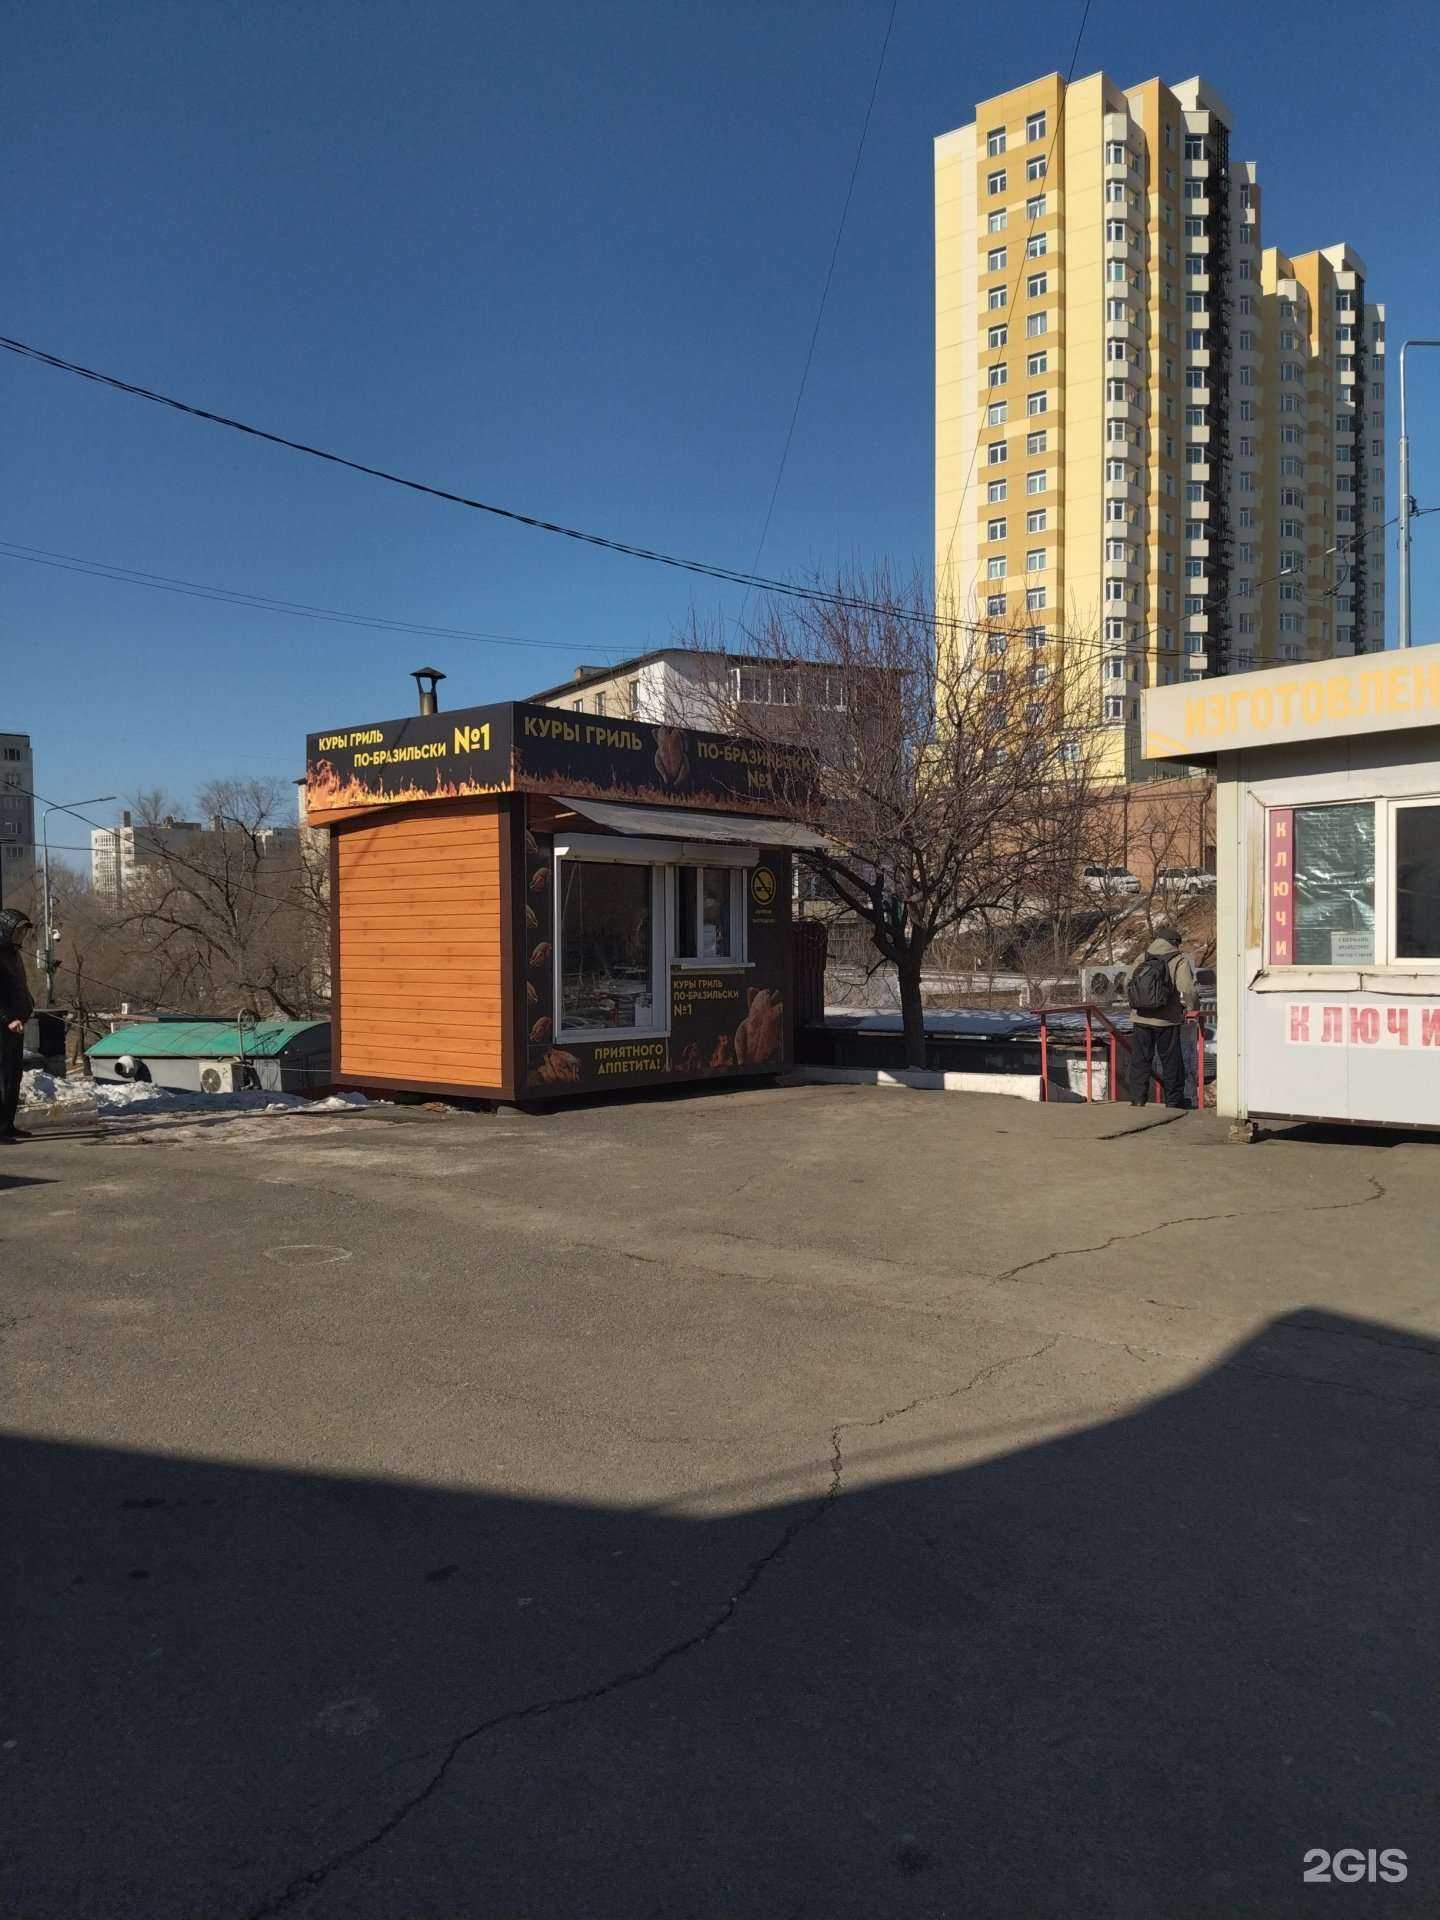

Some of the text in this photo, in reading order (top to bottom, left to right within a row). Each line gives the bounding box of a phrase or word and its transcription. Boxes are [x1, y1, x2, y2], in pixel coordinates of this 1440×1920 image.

[318, 729, 384, 751] КУРЫ ГРИЛЬ
[454, 722, 490, 754] №1
[524, 716, 642, 750] КУРЫ ГРИЛЬ
[354, 742, 446, 767] ПО-БРАЗИЛЬСКИ
[1273, 822, 1289, 956] КЛЮЧИ
[673, 979, 723, 989] КУРЫ ГРИЛЬ
[673, 1004, 693, 1016] №1
[1290, 1005, 1440, 1046] КЛЮЧИ
[594, 1043, 664, 1060] ПРИЯТНОГО
[598, 1059, 661, 1075] АППЕТИТА!
